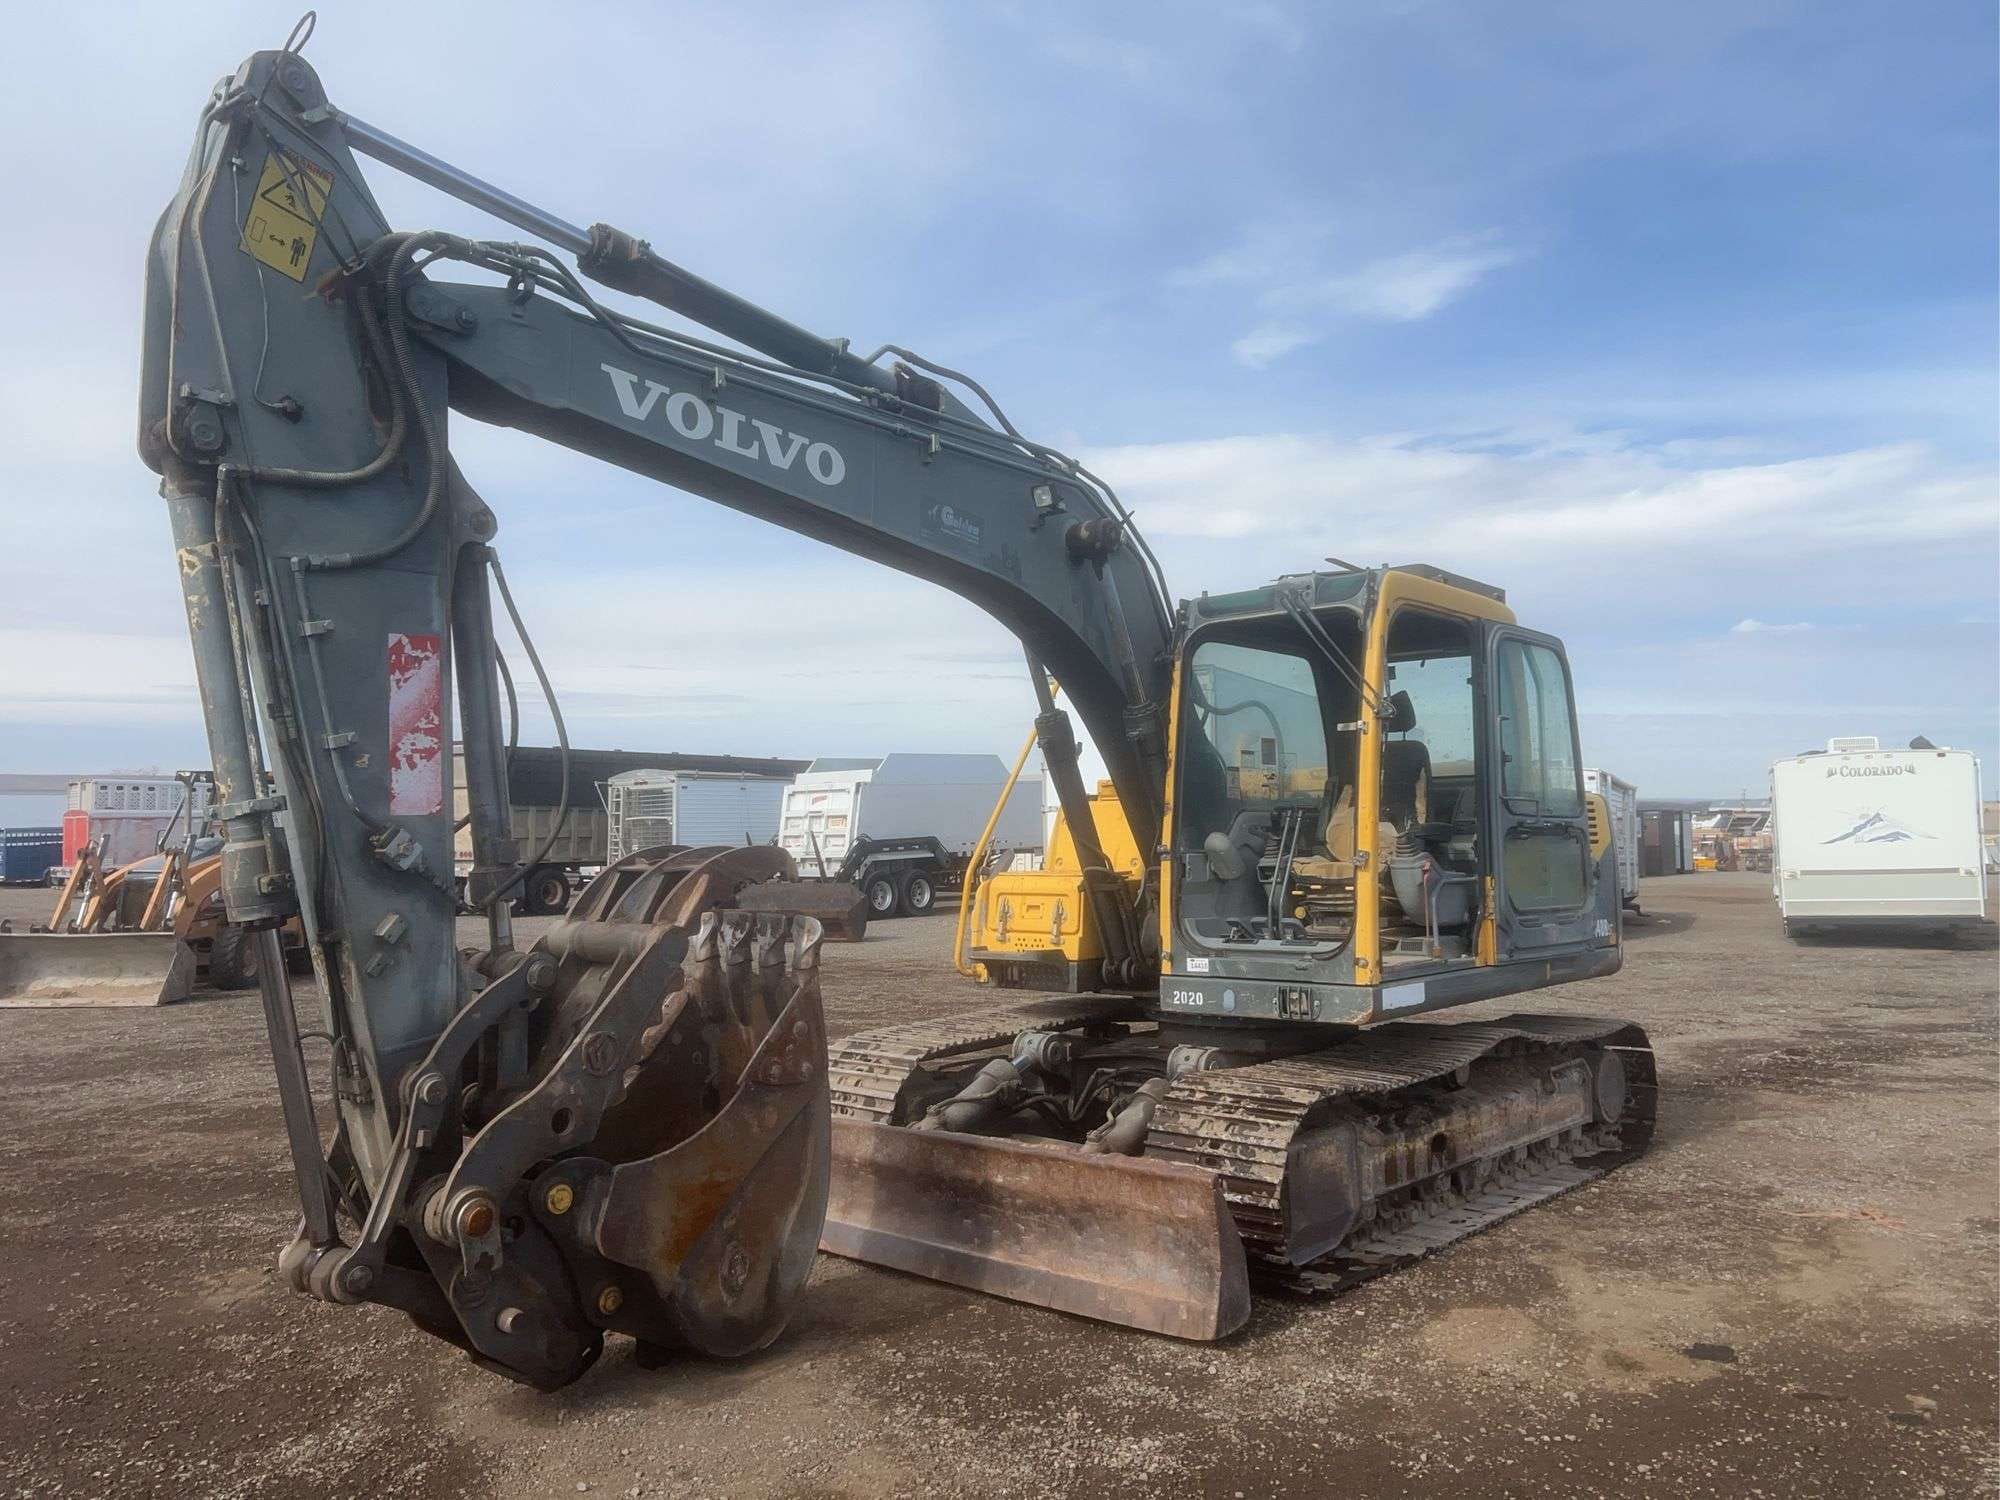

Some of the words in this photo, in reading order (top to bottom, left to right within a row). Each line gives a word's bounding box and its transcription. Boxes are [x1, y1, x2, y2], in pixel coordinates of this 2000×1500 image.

[600, 362, 846, 486] VOLVO
[1840, 765, 1903, 777] COLORADO
[1173, 990, 1204, 1006] 2020
